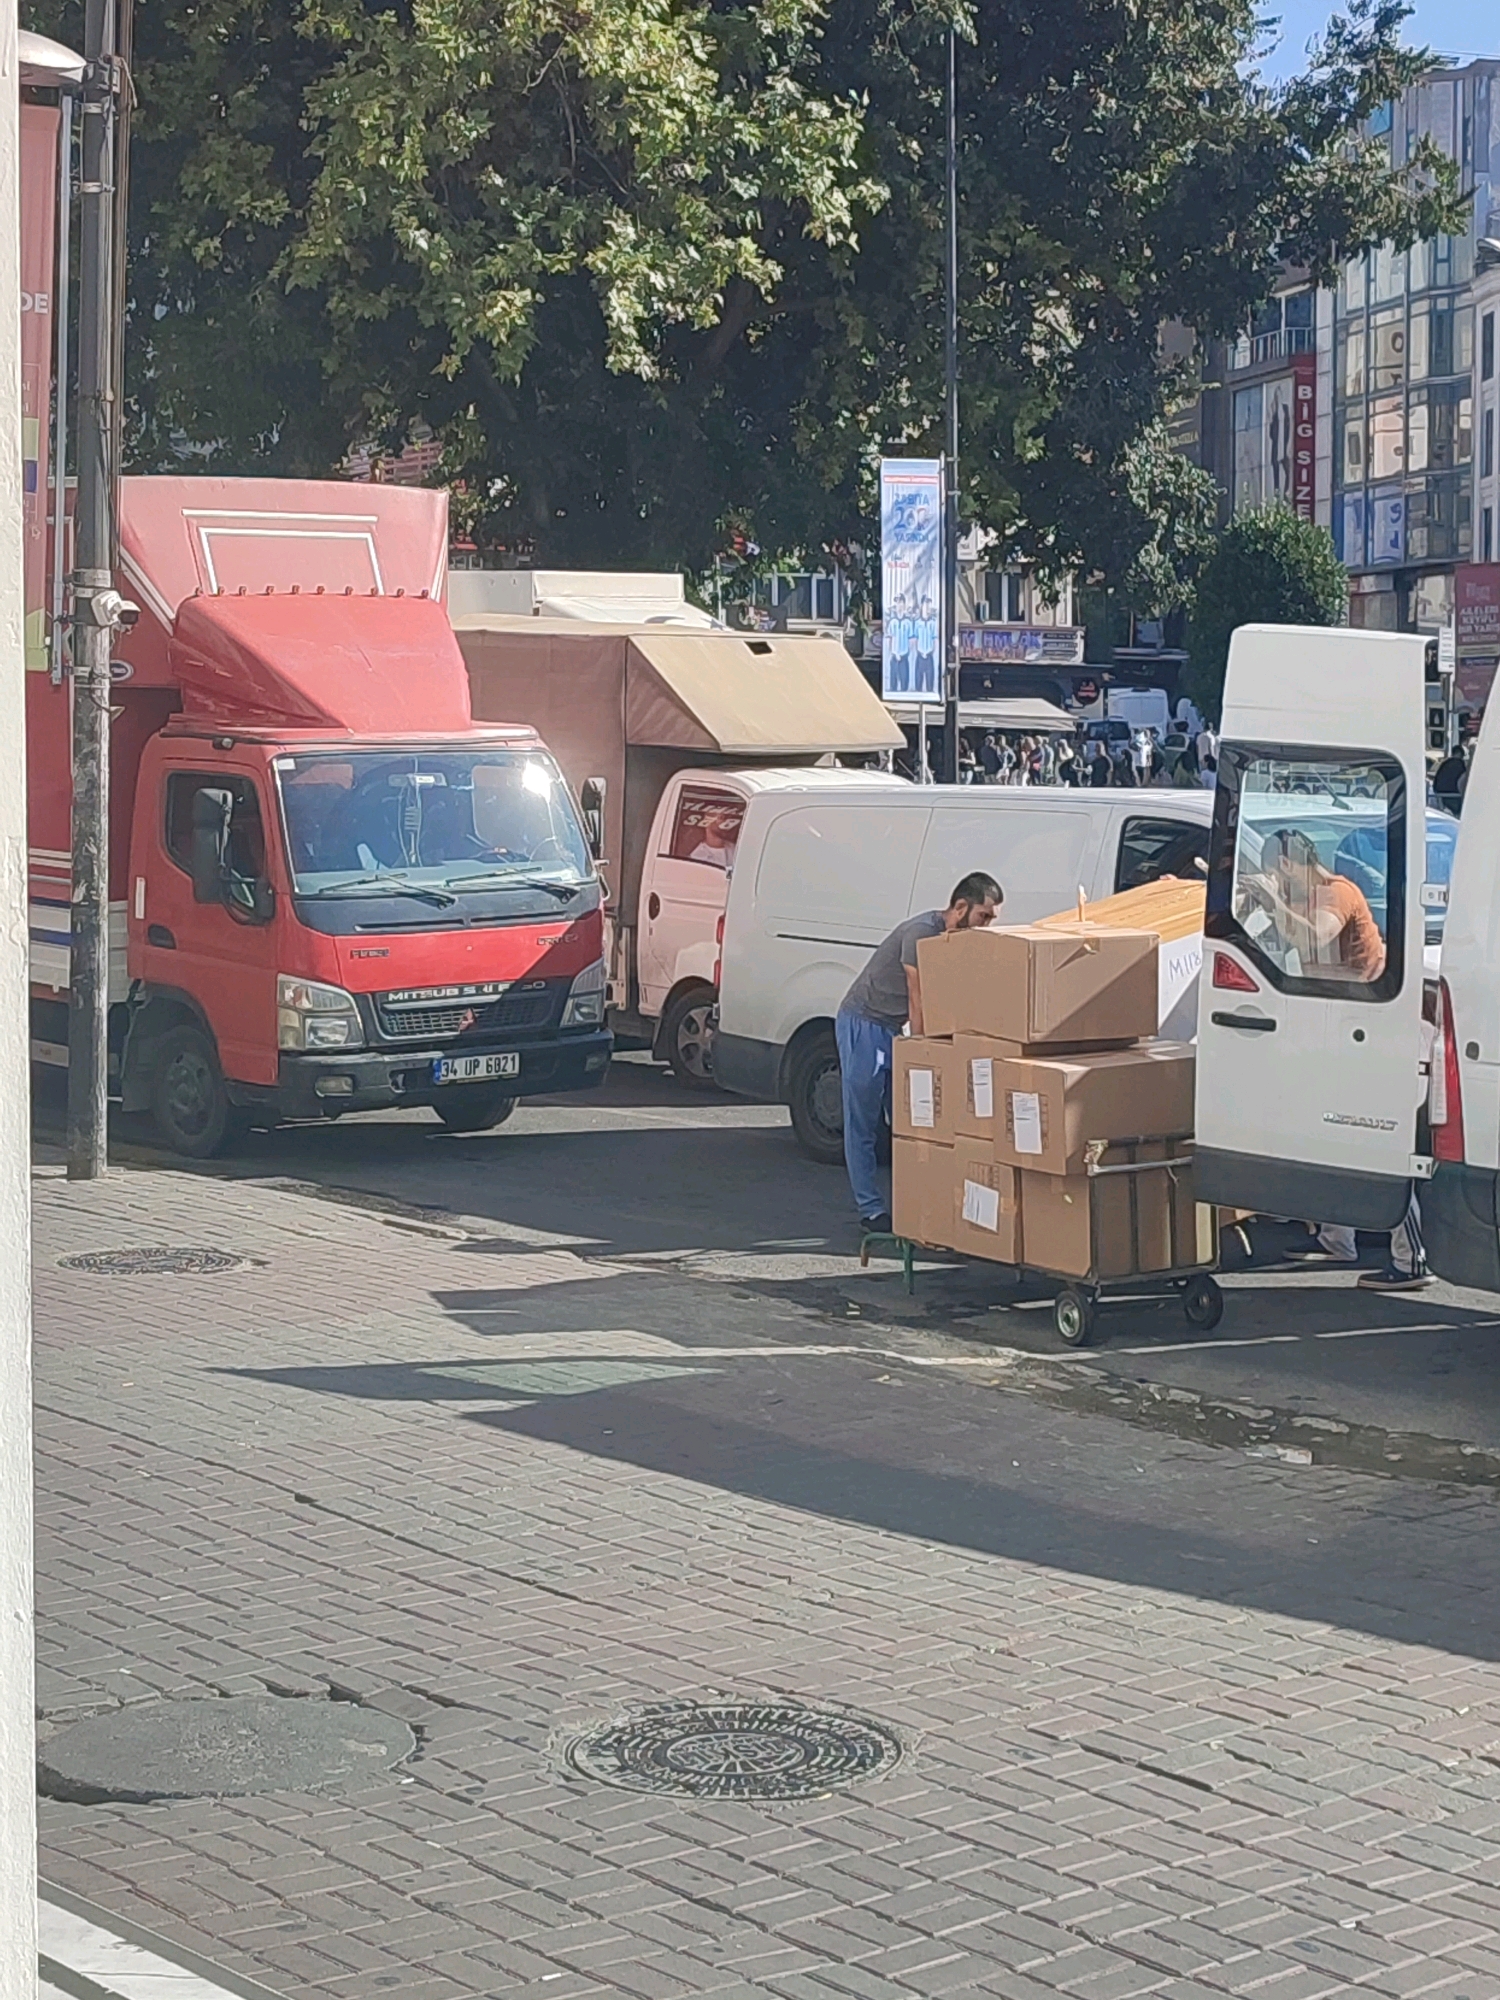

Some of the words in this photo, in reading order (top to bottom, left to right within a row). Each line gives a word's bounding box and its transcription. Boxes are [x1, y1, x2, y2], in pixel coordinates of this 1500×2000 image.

[388, 985, 493, 1001] MITSUBSHI
[441, 1060, 458, 1078] 34
[464, 1058, 481, 1076] UP
